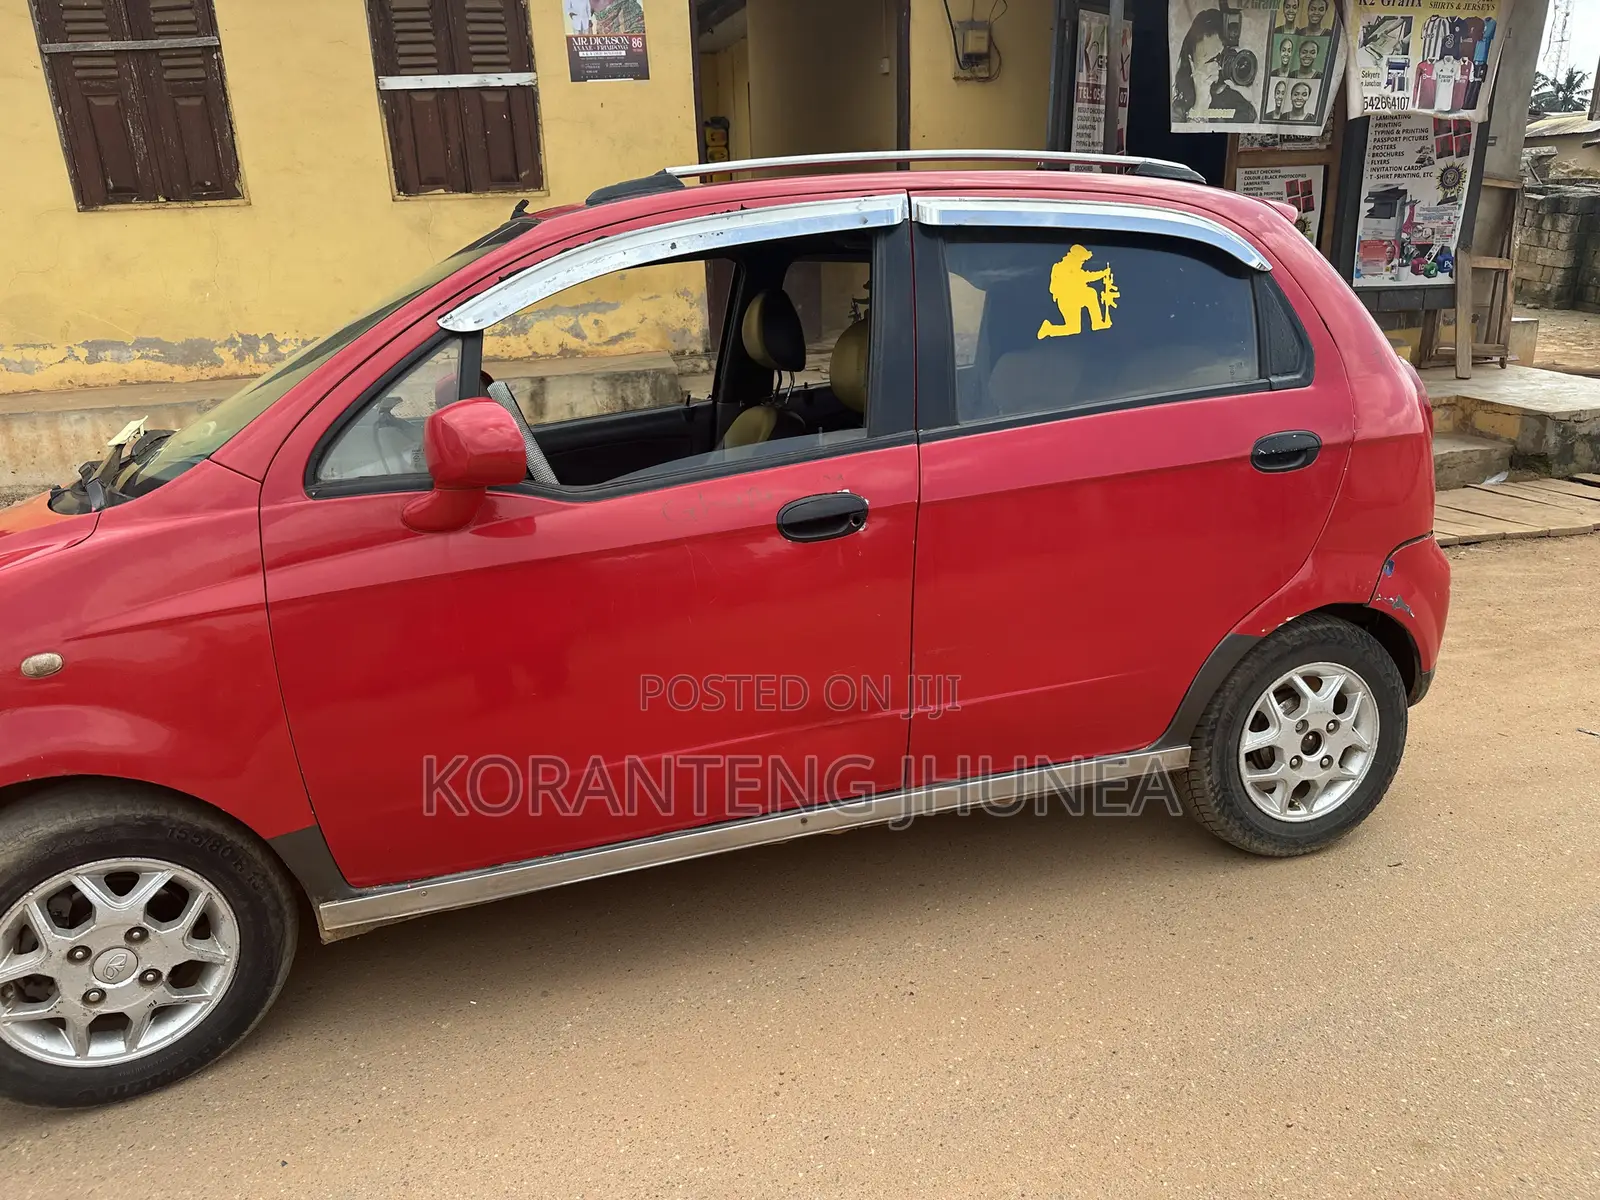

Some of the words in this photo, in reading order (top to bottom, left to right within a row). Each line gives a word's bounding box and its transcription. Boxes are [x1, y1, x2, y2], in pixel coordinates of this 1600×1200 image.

[1428, 2, 1454, 10] SHIRTS
[1462, 3, 1496, 12] JERSEYS
[590, 36, 630, 45] DICKSON
[631, 37, 643, 48] 86
